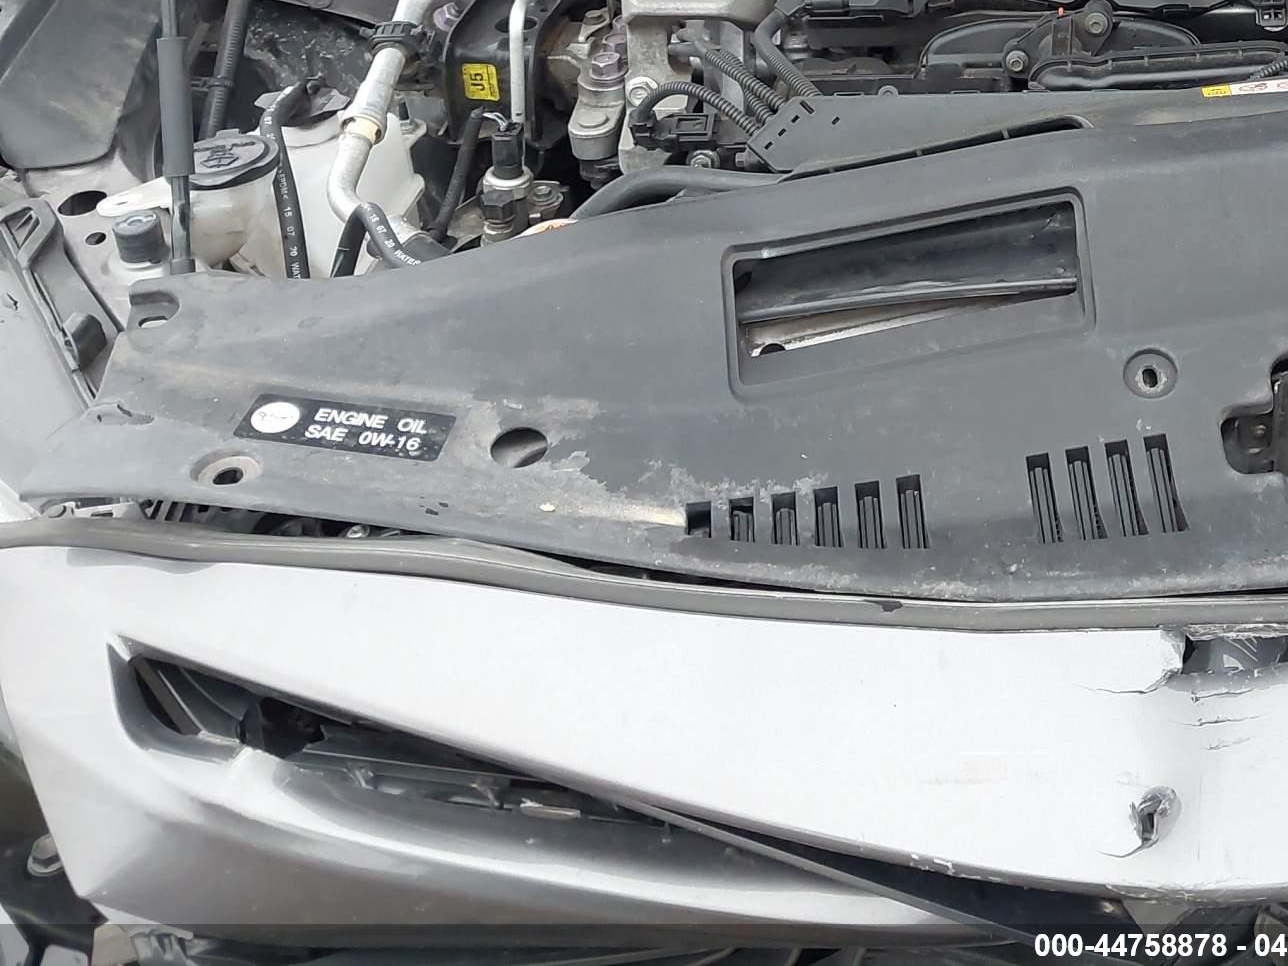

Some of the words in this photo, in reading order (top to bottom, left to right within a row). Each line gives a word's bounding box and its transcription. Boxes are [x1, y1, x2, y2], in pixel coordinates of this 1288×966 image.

[470, 72, 486, 92] J5
[283, 206, 293, 218] 15
[313, 407, 389, 430] ENGINE
[396, 417, 428, 435] OIL
[304, 424, 349, 442] SAE
[358, 431, 421, 452] 0W-16
